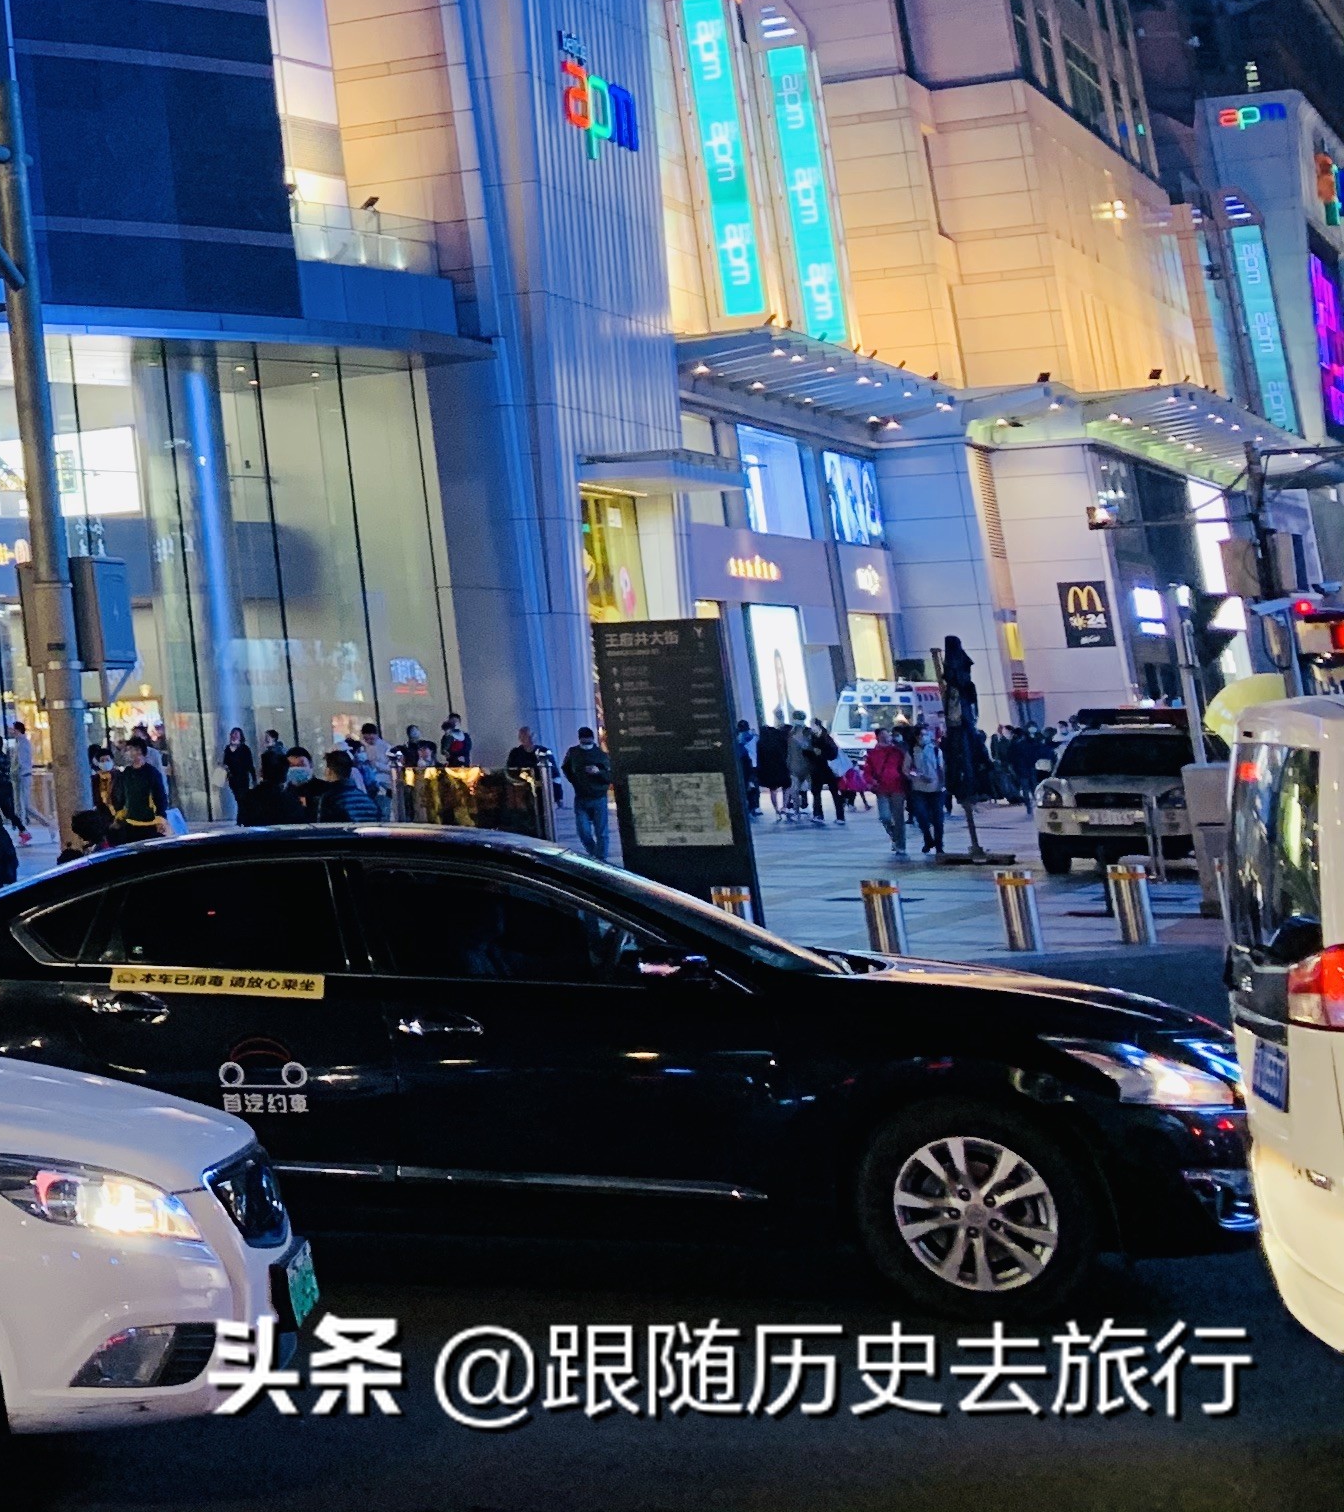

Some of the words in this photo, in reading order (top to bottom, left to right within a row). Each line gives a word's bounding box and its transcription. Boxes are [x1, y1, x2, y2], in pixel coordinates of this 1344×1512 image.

[692, 20, 722, 81] apm
[562, 60, 640, 161] apm
[777, 73, 806, 130] apm
[1218, 102, 1287, 130] apm
[705, 121, 737, 183] apm
[789, 167, 819, 225] apm
[720, 223, 751, 286] apm
[1237, 244, 1261, 285] apm
[805, 262, 835, 321] apm
[1250, 311, 1274, 353] apm
[604, 629, 680, 648] 王府井大街
[140, 972, 224, 987] 本车已消毒
[229, 975, 316, 992] 请放心乘坐
